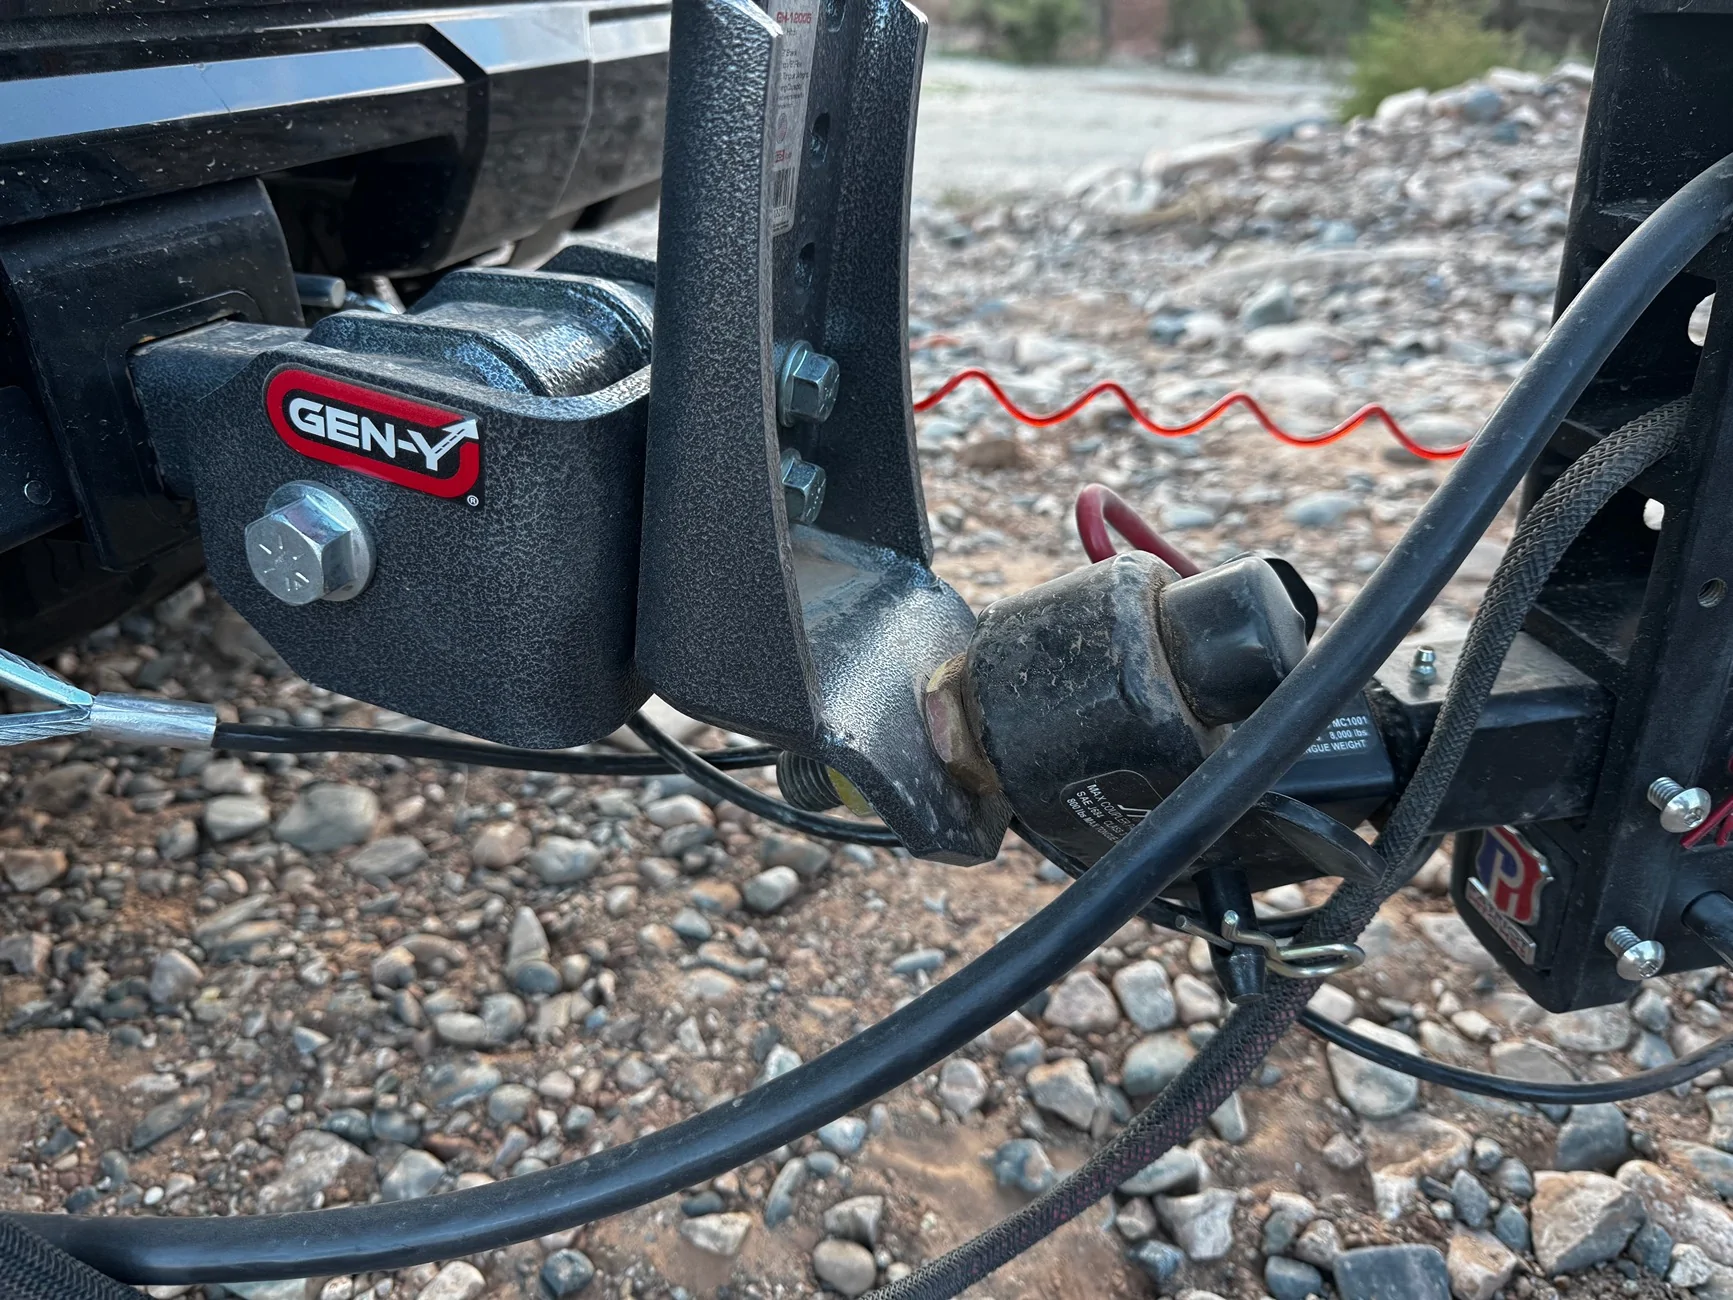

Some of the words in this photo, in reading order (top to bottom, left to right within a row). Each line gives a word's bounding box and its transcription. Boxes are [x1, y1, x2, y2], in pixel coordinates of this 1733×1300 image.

[289, 397, 479, 472] GEN-Y
[1332, 716, 1368, 728] MC1001
[1329, 729, 1352, 740] 8,000
[1353, 728, 1369, 738] lbs
[1305, 743, 1331, 754] NGUE
[1331, 739, 1367, 751] WEIGHT
[1076, 791, 1094, 806] SAE
[1086, 783, 1107, 802] MAX
[1066, 797, 1082, 811] 800
[1074, 808, 1087, 818] lbs
[1082, 815, 1100, 828] MAX
